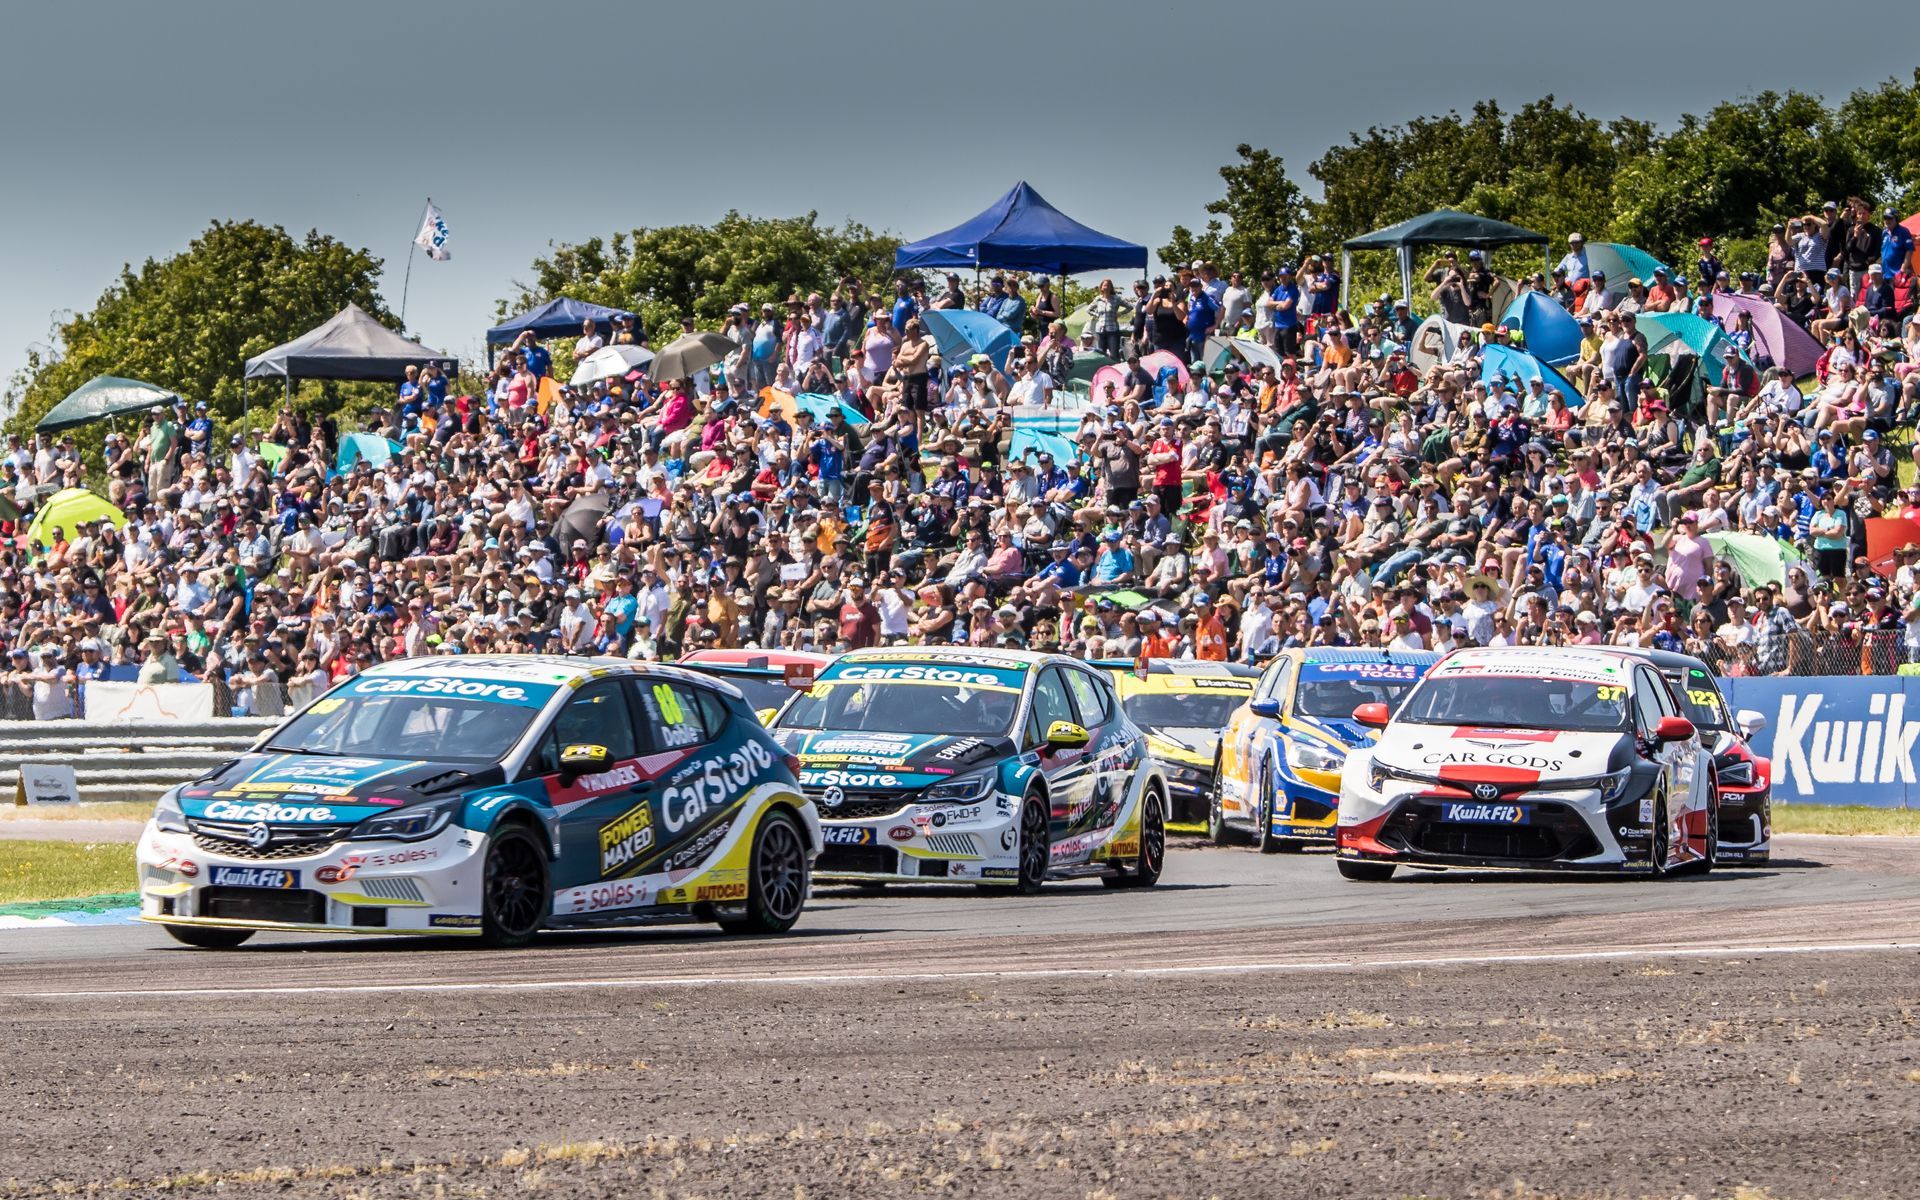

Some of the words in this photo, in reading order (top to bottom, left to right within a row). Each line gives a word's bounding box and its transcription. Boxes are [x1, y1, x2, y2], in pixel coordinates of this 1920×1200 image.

[1319, 664, 1416, 673] CARLYLE
[1360, 670, 1415, 679] TOOLS
[1550, 670, 1619, 683] Kingdom
[1596, 686, 1621, 701] 37
[1686, 690, 1720, 706] 123
[653, 683, 684, 725] 88
[936, 736, 985, 760] EPIMAX
[1772, 693, 1920, 795] Kwik
[1423, 752, 1475, 765] CAR
[1486, 752, 1564, 772] GODS
[604, 808, 650, 849] POWER
[604, 827, 652, 869] MAXED
[696, 883, 746, 900] AUTOCAR
